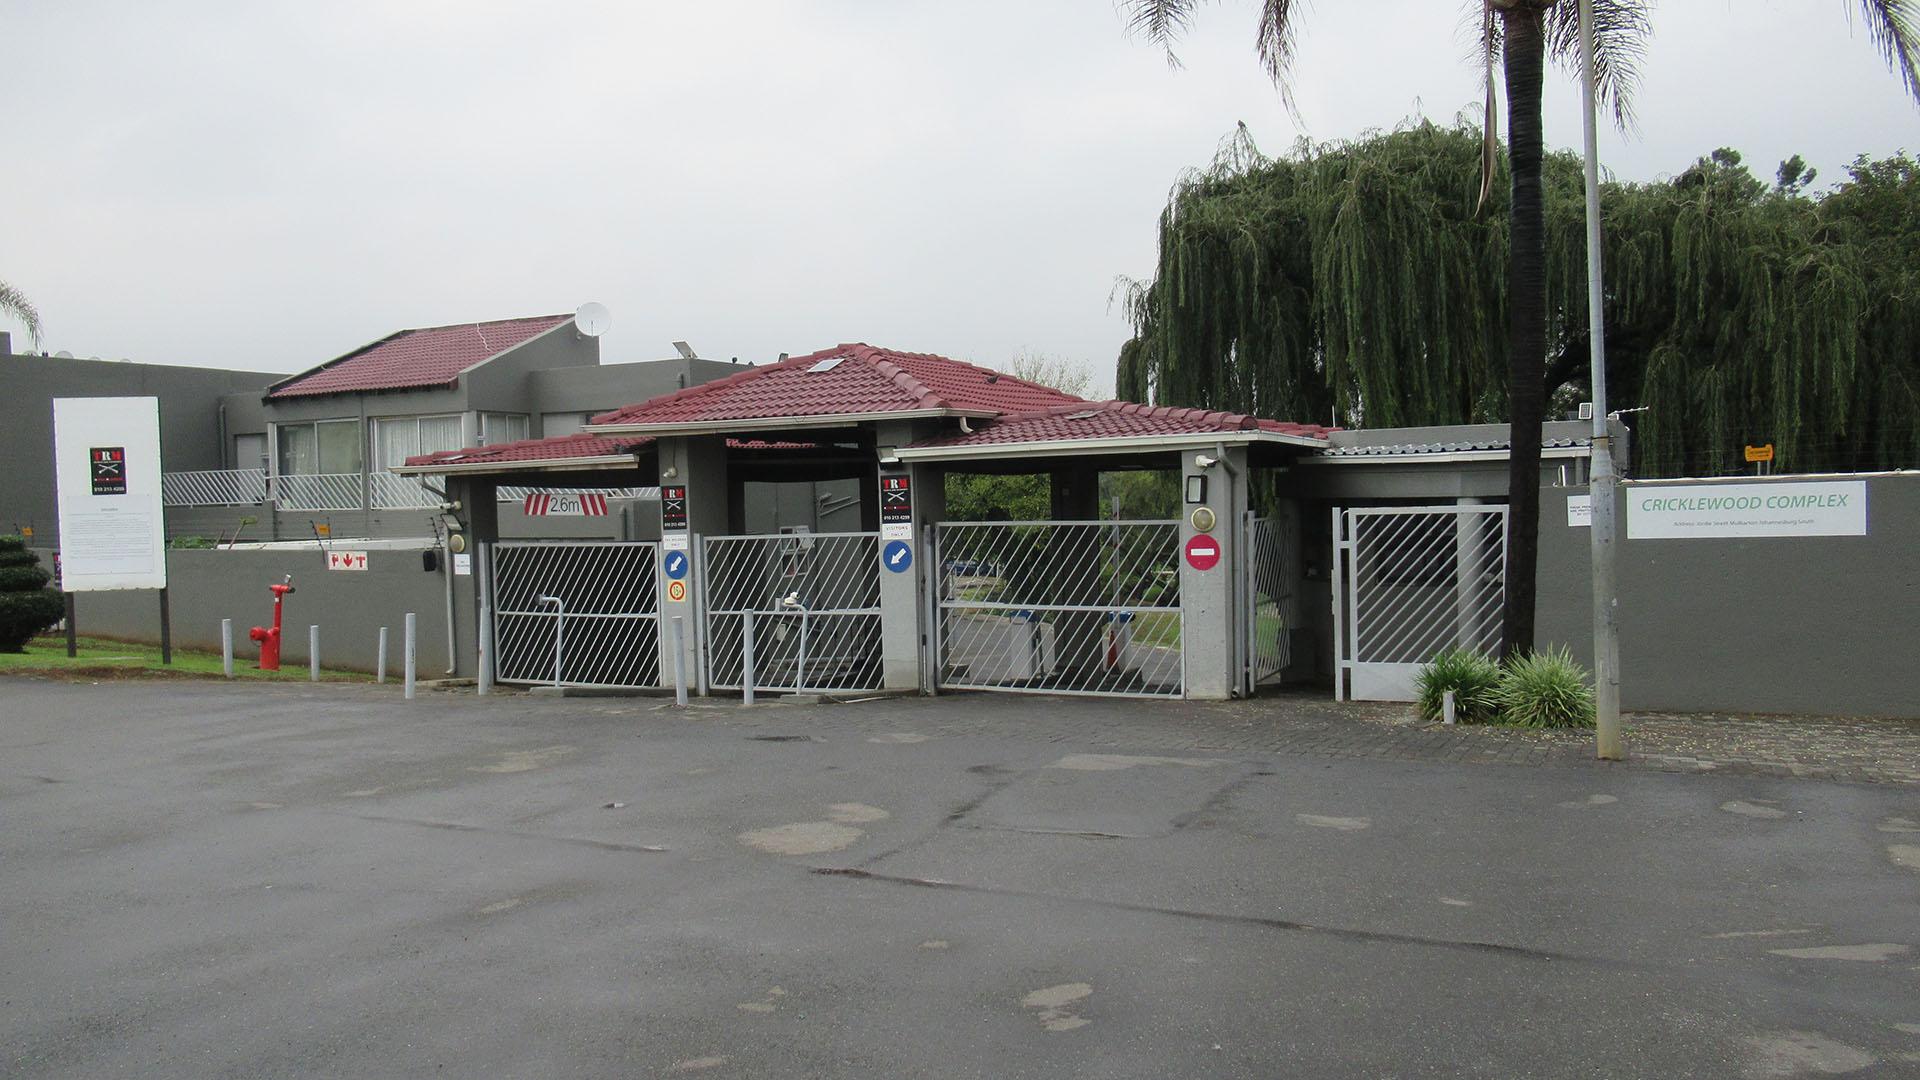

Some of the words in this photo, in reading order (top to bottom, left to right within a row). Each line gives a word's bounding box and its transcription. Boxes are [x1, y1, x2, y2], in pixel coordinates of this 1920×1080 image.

[550, 497, 579, 512] 2.6m
[1641, 496, 1761, 511] CRICKLEWOOD
[1766, 494, 1849, 509] COMPLEX
